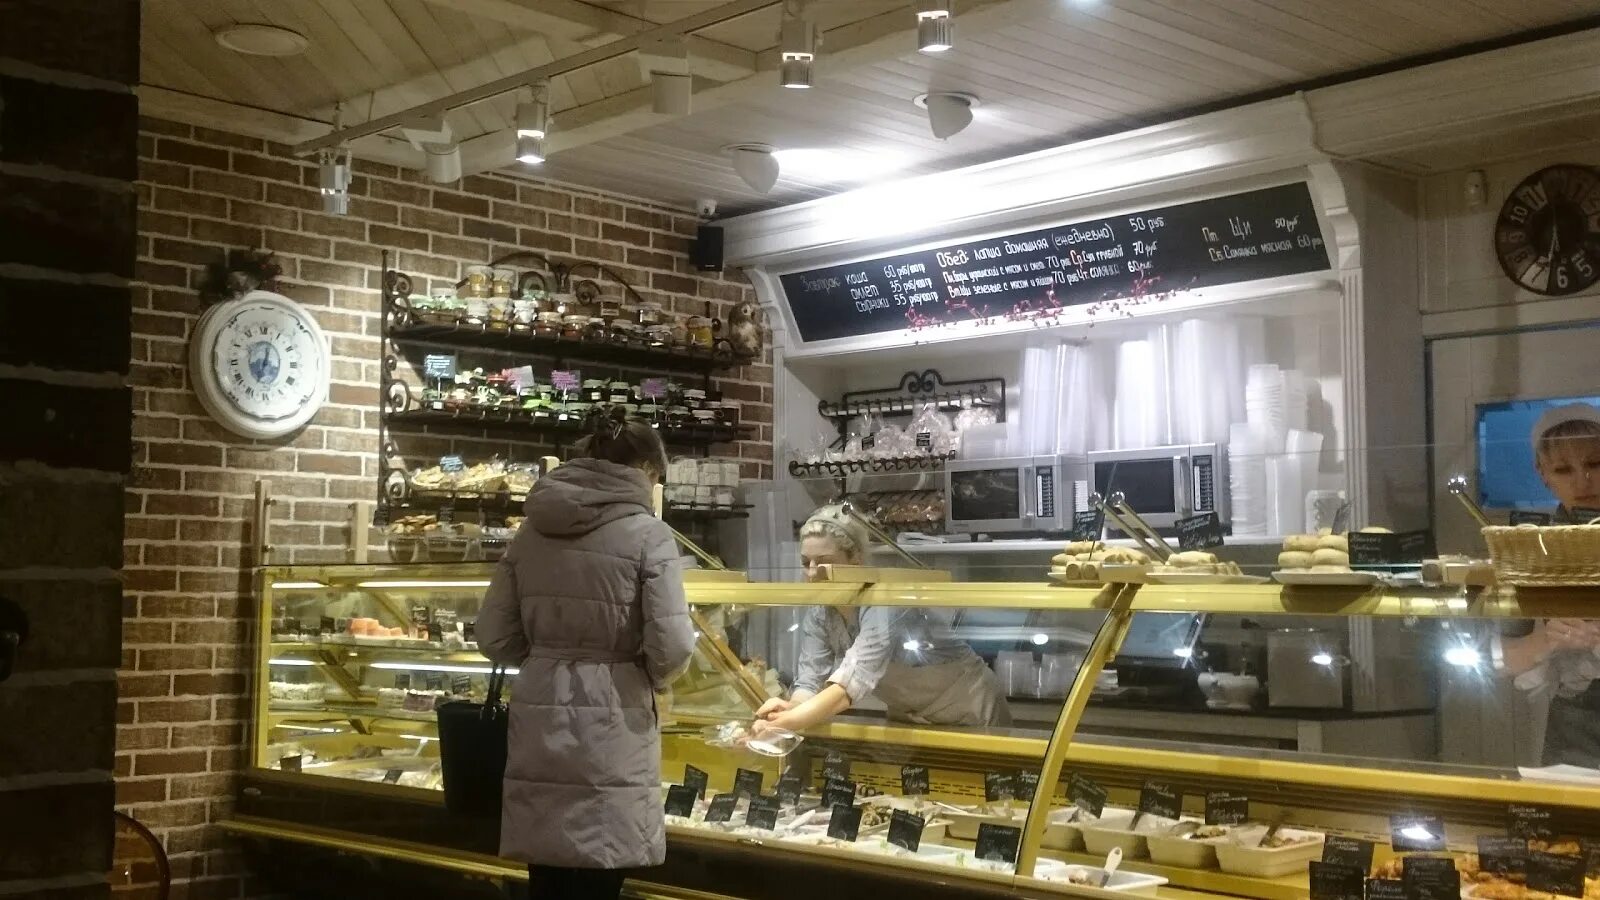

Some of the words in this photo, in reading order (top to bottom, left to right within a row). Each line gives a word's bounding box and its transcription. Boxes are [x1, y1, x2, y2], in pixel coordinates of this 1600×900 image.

[1510, 206, 1528, 223] 10
[1275, 217, 1286, 229] 50
[936, 250, 969, 268] Обед:
[1051, 223, 1115, 251] (ежедневно)
[1129, 217, 1146, 232] 50
[1147, 217, 1165, 234] руб
[1132, 240, 1145, 256] 70
[1297, 234, 1311, 248] 60
[1045, 255, 1060, 269] 70
[1127, 260, 1139, 273] 60
[1574, 260, 1593, 278] 5
[884, 264, 897, 279] 60
[1051, 271, 1065, 283] 70
[1557, 266, 1568, 288] 6
[890, 279, 902, 293] 35
[894, 293, 907, 306] 55
